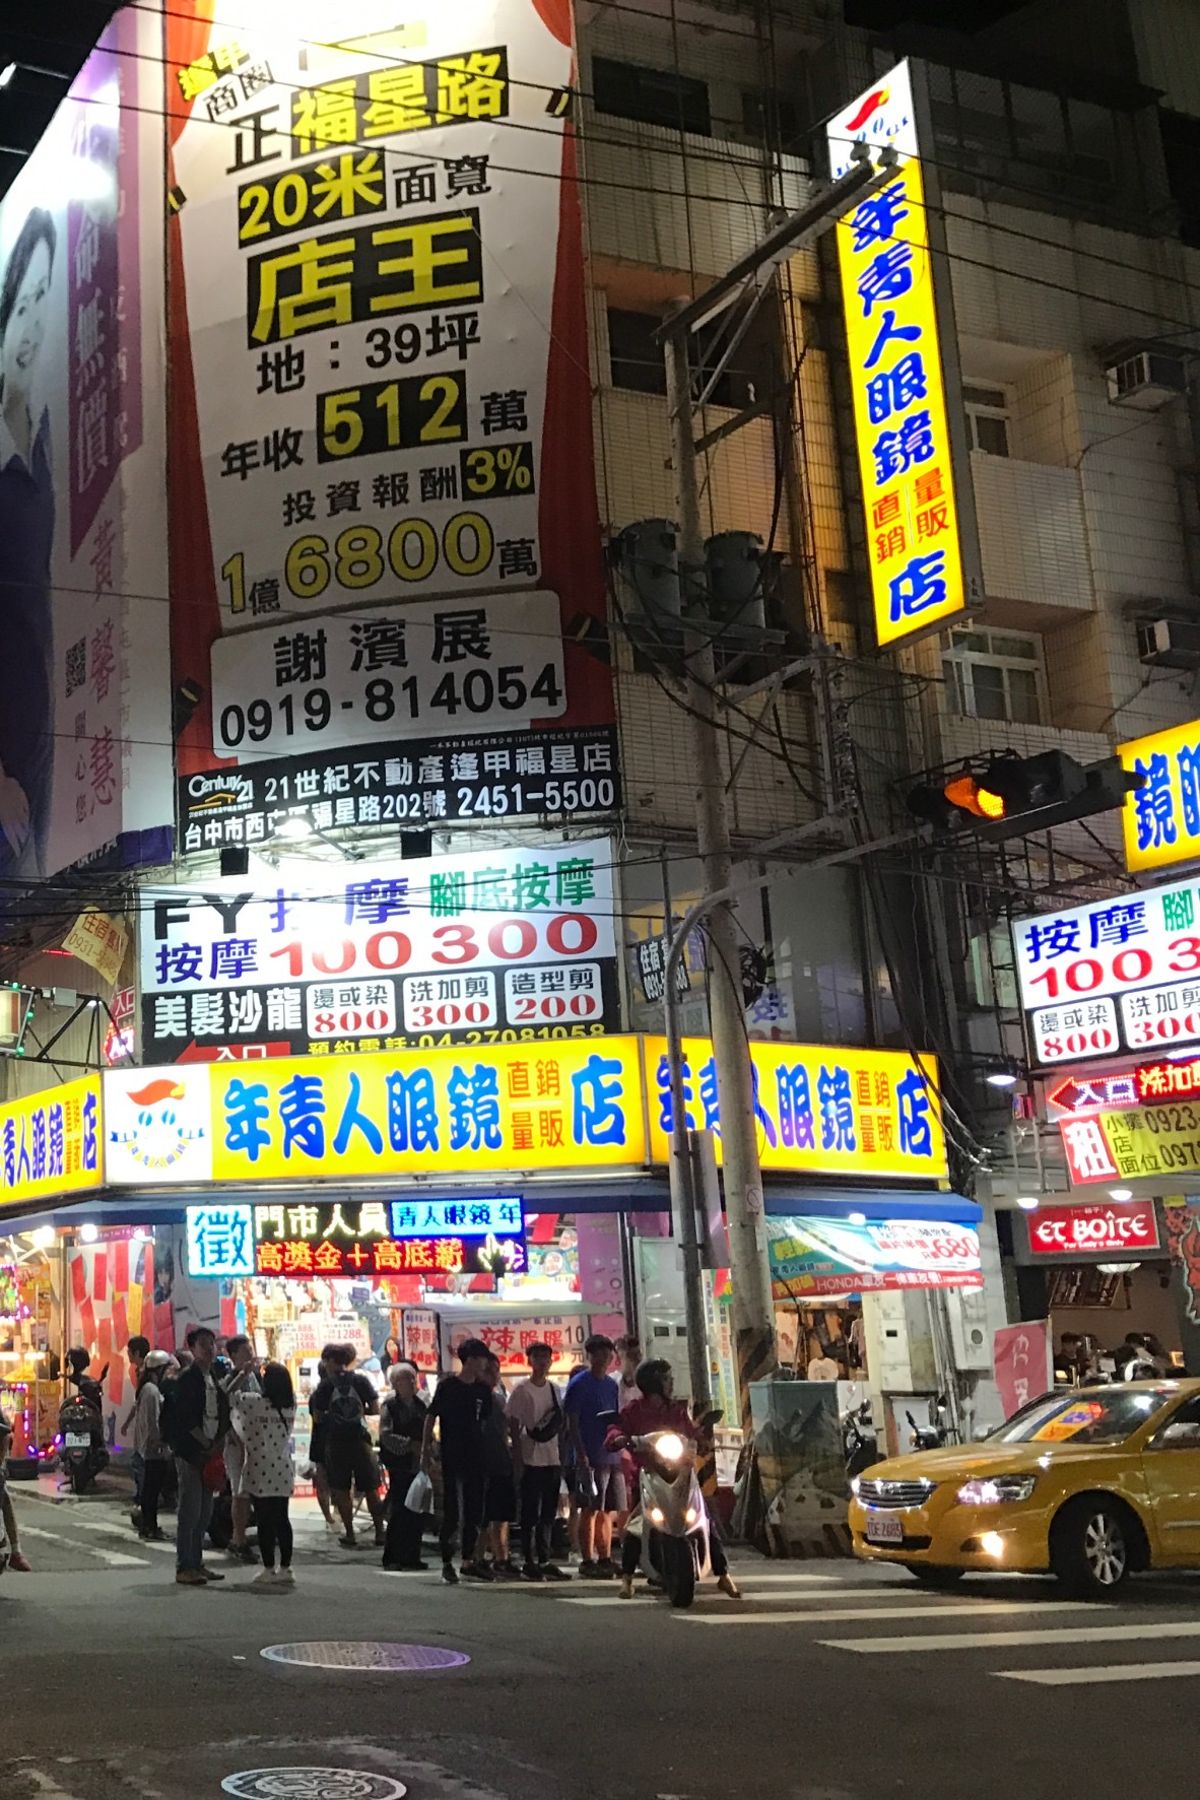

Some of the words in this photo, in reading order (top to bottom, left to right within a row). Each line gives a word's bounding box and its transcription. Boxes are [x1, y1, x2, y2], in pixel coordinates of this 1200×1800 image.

[251, 216, 481, 342] 店王
[851, 180, 933, 485] 年青人眼鏡
[889, 549, 946, 624] 店
[220, 663, 563, 746] 0919-814054
[265, 743, 612, 802] 21世紀不動產逢甲福星店
[458, 779, 614, 816] 2451-5500
[155, 892, 255, 940] FY
[1025, 900, 1148, 963] 按摩
[156, 938, 258, 985] 按摩
[270, 930, 412, 977] 100
[432, 913, 598, 965] 300
[1029, 947, 1153, 998] 100
[411, 976, 489, 1002] 洗加剪
[512, 968, 594, 995] 造型剪
[154, 987, 303, 1038] 美髮沙龍
[315, 1009, 389, 1034] 800
[412, 1002, 490, 1028] 300
[514, 994, 596, 1020] 200
[1044, 1028, 1112, 1058] 800
[507, 1060, 561, 1099] 直銷
[571, 1054, 627, 1147] 店
[856, 1069, 891, 1107] 直銷
[1073, 1079, 1136, 1107] 入口
[223, 1063, 502, 1162] 年青人眼鏡
[509, 1109, 563, 1150] 量販
[860, 1115, 894, 1153] 量販
[896, 1069, 932, 1156] 店
[1064, 1119, 1117, 1178] 租
[194, 1209, 250, 1268] 徵
[255, 1202, 390, 1238] 門市人員
[932, 1236, 980, 1258] 680
